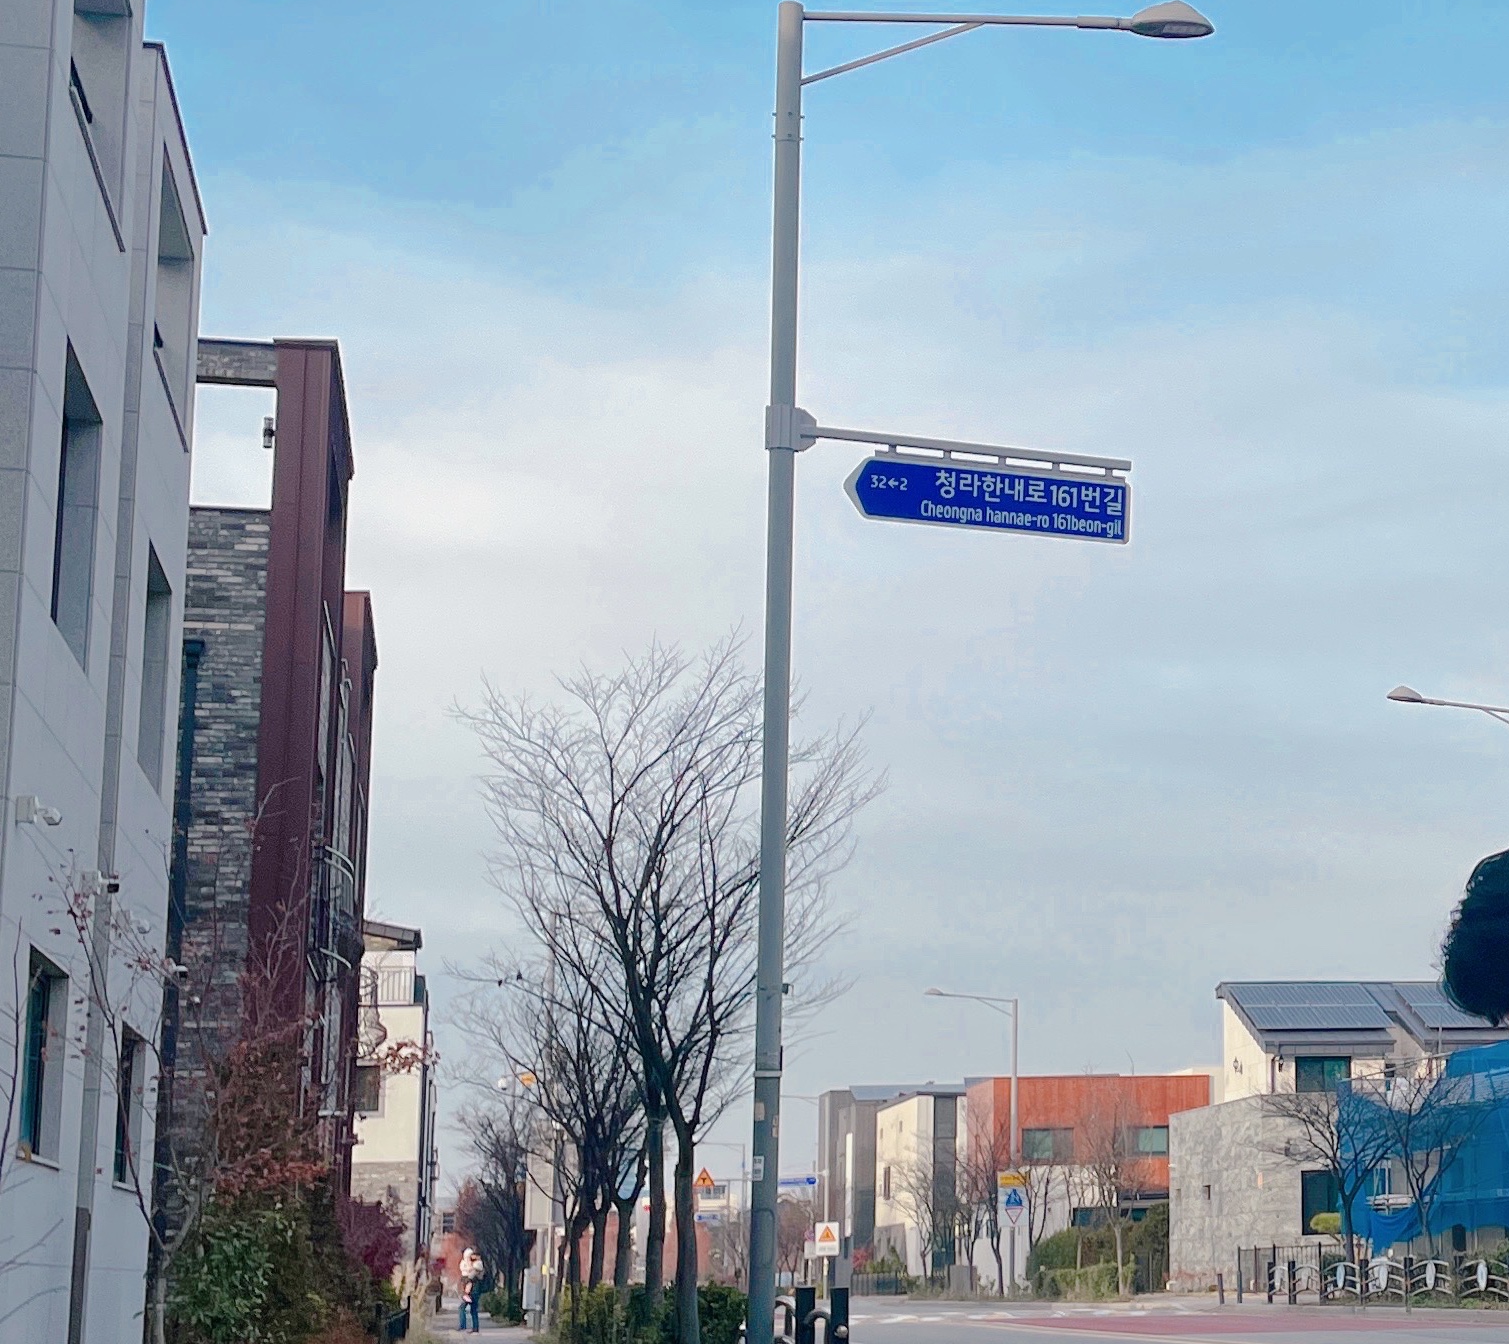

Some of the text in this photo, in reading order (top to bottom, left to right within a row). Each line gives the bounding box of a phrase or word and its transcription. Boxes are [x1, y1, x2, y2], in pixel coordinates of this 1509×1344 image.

[870, 474, 908, 491] 32 2
[920, 499, 1122, 538] Cheongna hannae-ro 161beon-gil
